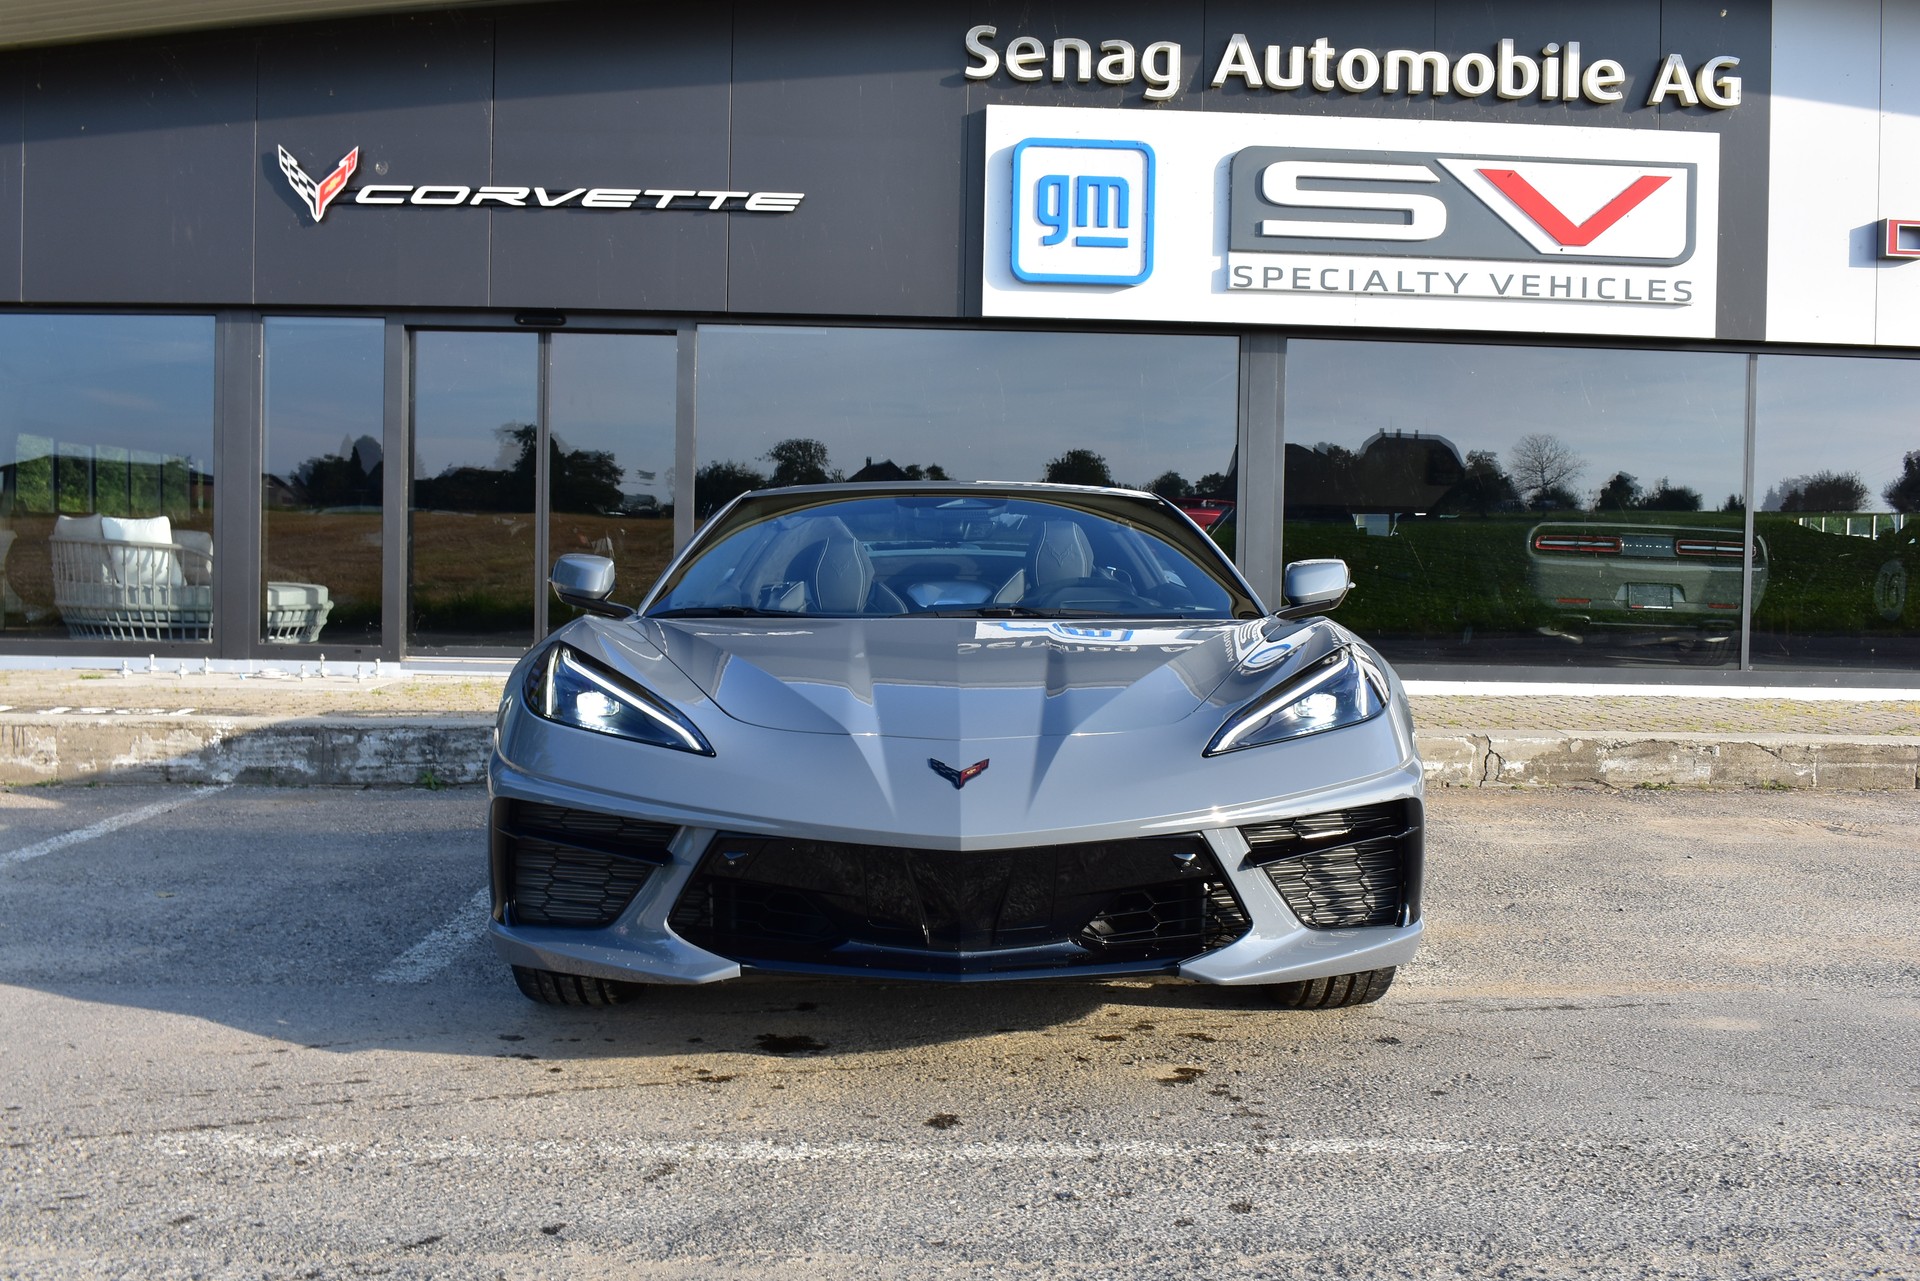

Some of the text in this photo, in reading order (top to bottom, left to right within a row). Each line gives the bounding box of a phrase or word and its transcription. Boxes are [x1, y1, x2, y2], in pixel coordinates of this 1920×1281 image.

[964, 25, 1742, 110] Senag Automobile AG
[355, 185, 805, 212] CORVETTE
[1036, 174, 1130, 247] gm
[1261, 159, 1674, 255] SV
[1233, 265, 1693, 302] SPECIALTY VEHICLES
